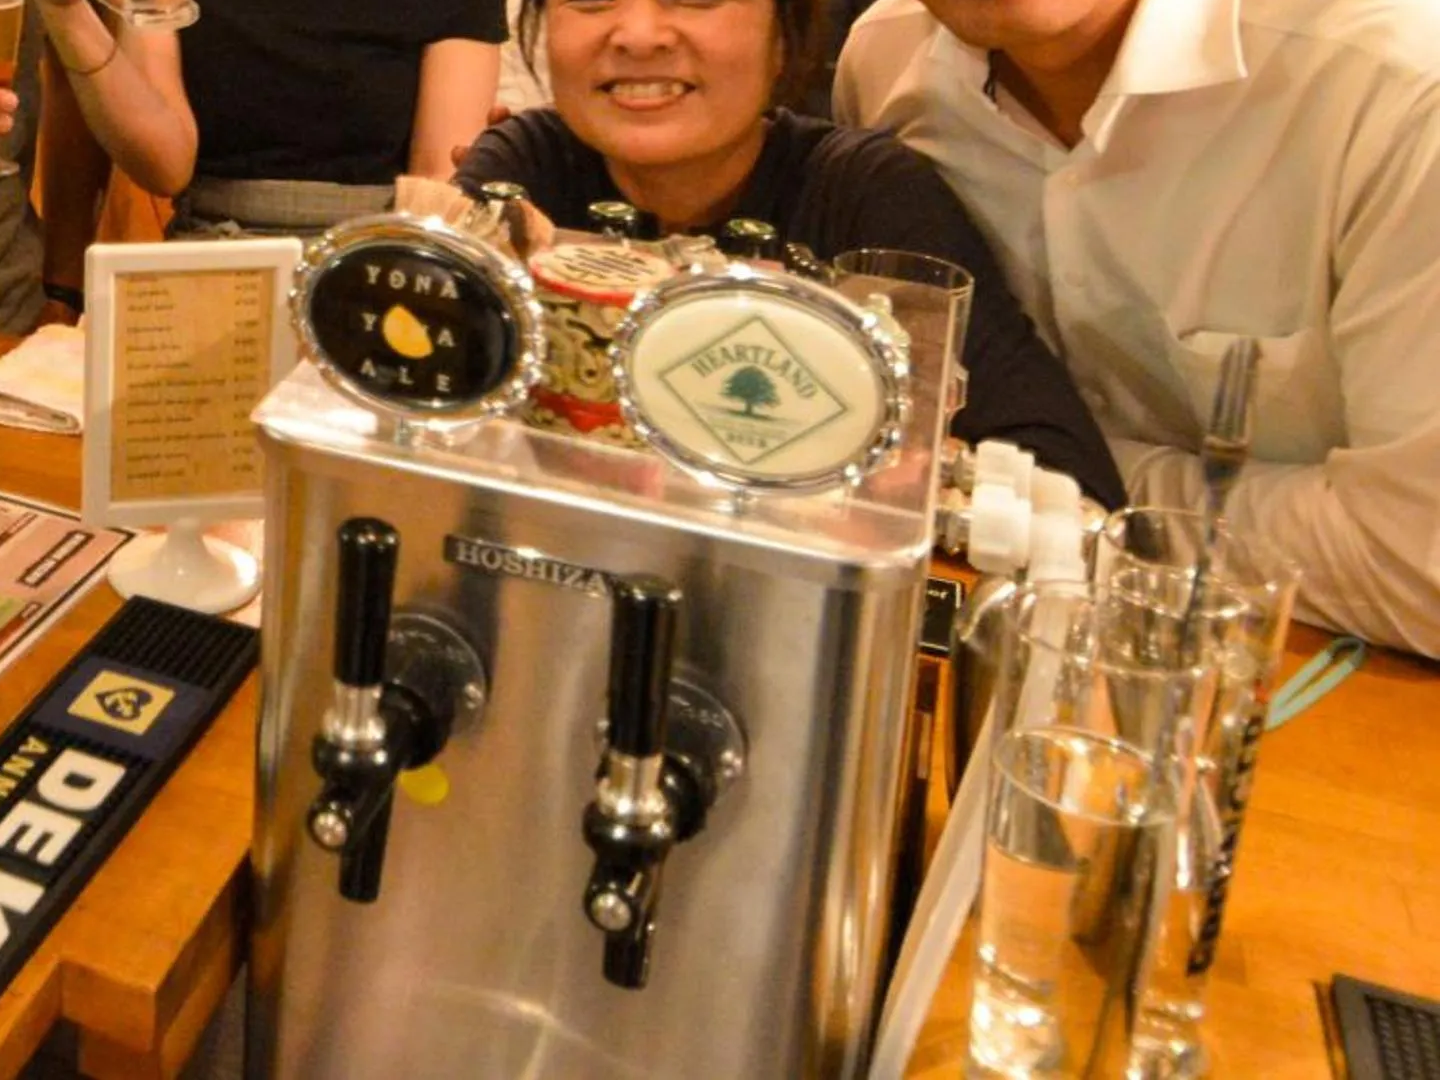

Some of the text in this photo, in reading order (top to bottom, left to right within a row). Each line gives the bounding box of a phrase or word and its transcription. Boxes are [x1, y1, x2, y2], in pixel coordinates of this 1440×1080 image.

[366, 264, 459, 300] YONA
[362, 312, 456, 348] YA
[360, 358, 451, 393] ALE
[691, 343, 818, 400] HEARTLAND
[456, 541, 608, 595] HOSHIZA
